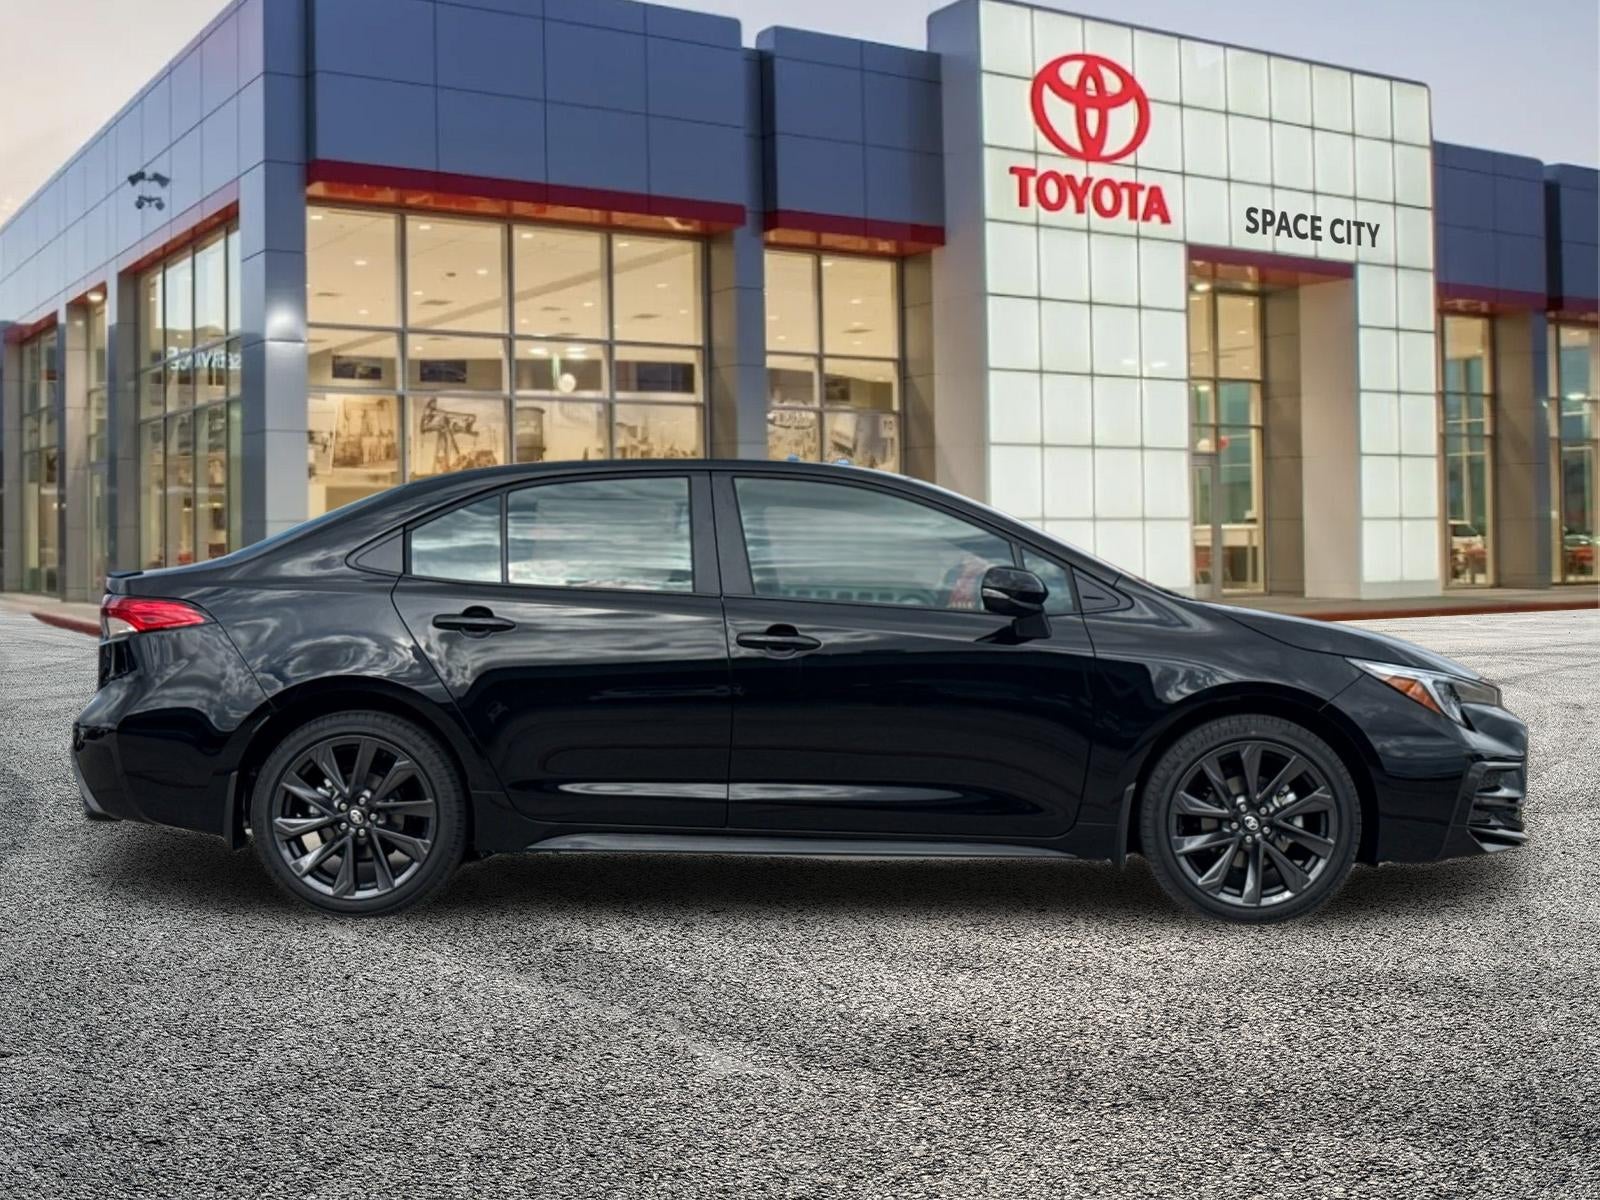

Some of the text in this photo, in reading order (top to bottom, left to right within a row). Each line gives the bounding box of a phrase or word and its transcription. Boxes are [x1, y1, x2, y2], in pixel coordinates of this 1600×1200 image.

[1009, 167, 1171, 224] TOYOTA
[1245, 206, 1381, 248] SPACE CITY
